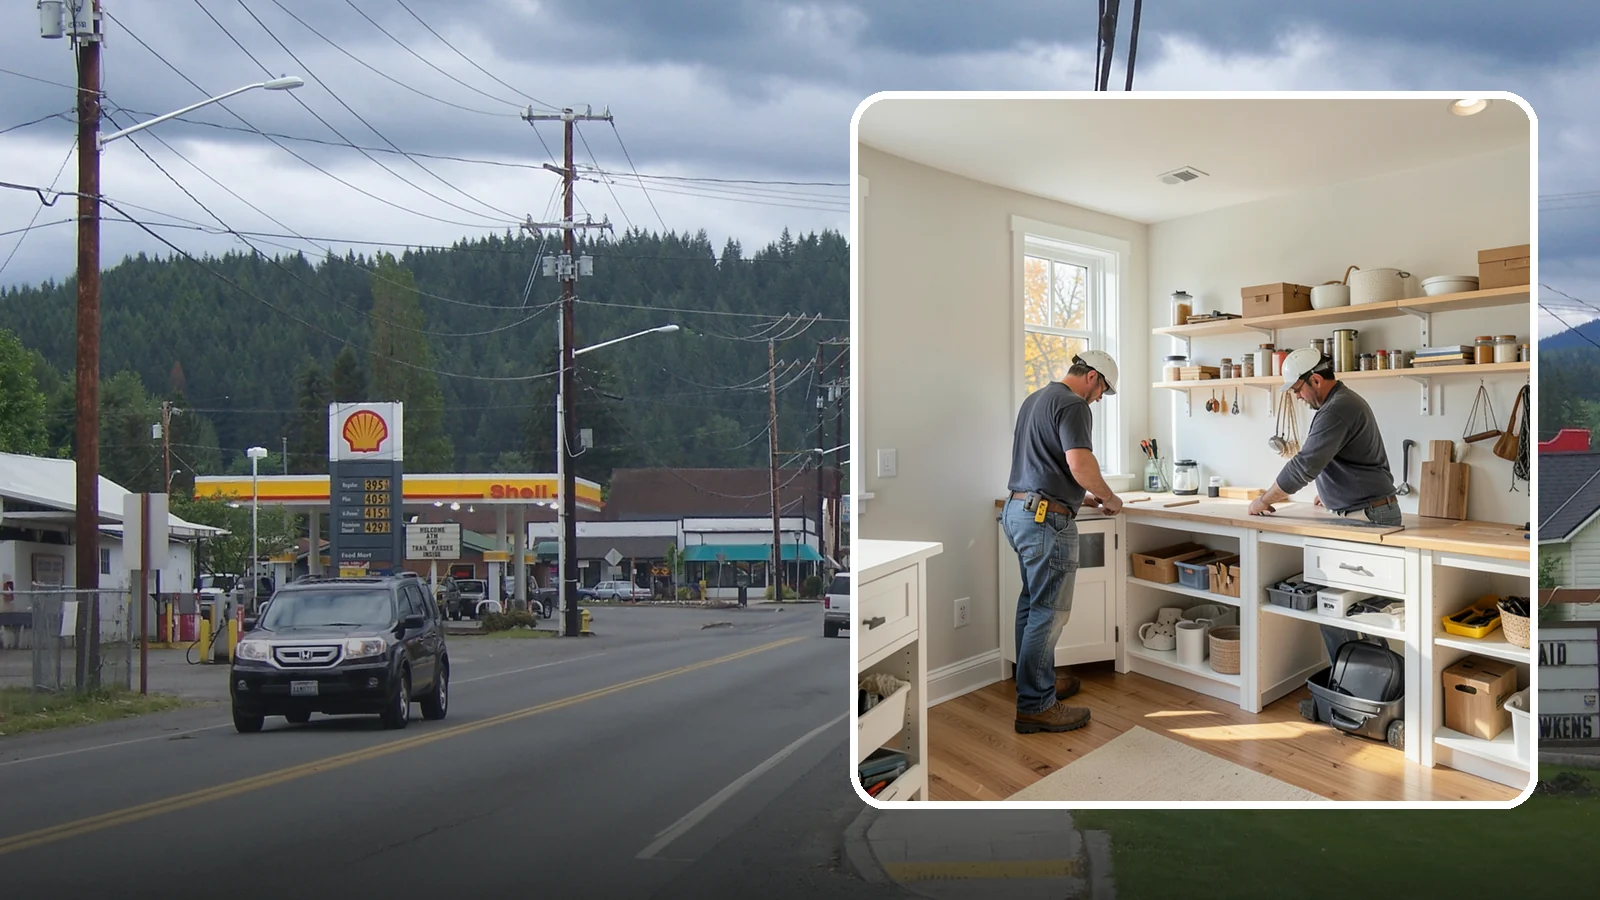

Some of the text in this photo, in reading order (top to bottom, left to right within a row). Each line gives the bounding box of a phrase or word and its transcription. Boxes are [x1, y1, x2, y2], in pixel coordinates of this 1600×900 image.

[490, 484, 547, 499] Shell
[365, 494, 384, 504] 405
[365, 508, 384, 518] 415
[365, 522, 384, 533] 429
